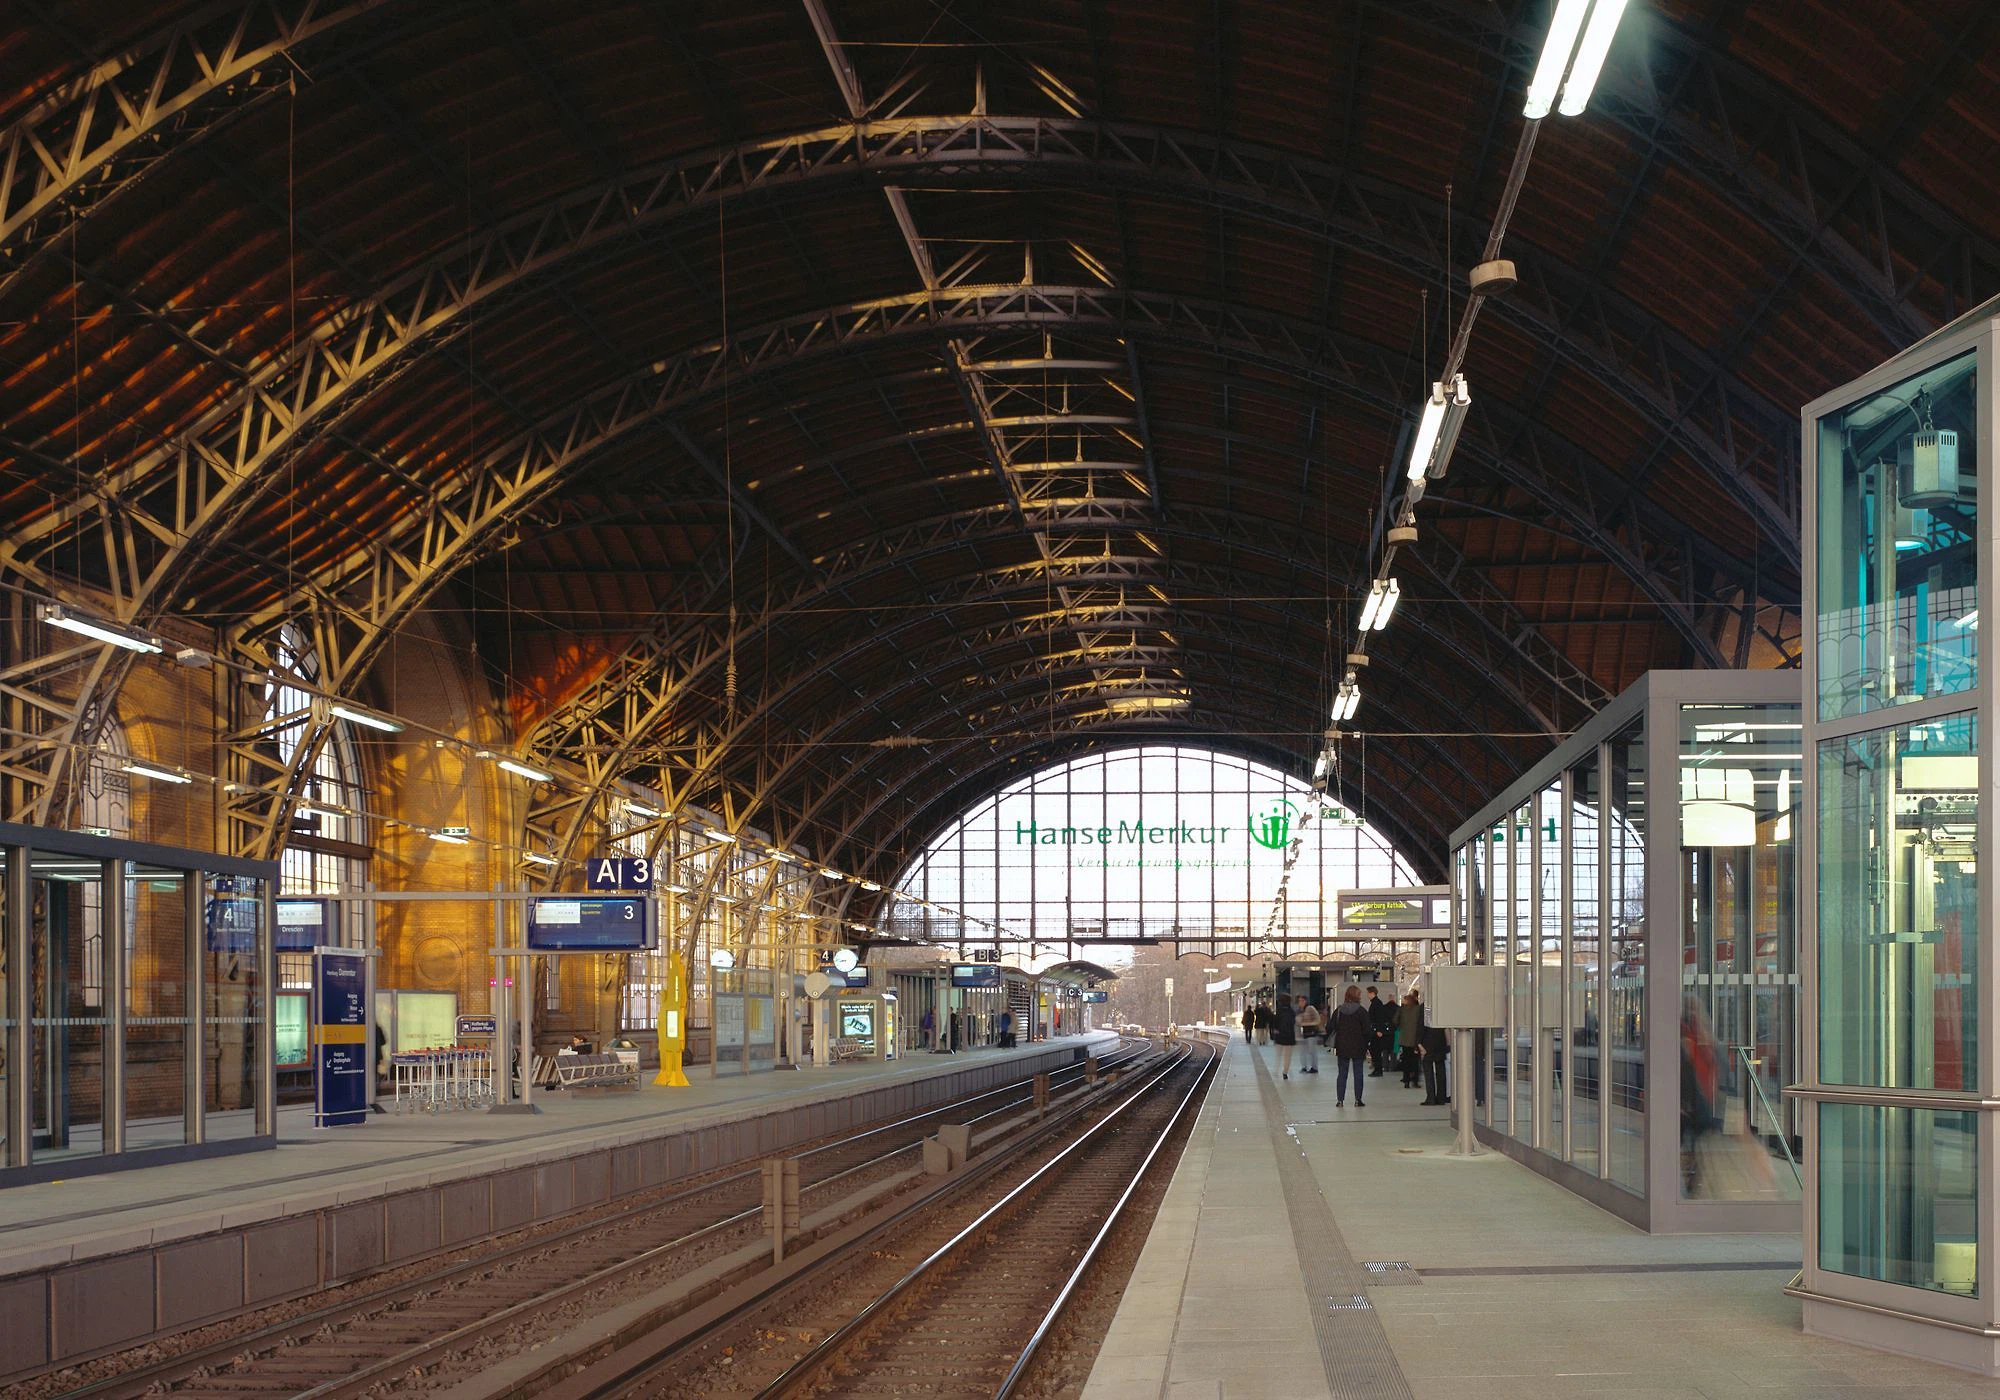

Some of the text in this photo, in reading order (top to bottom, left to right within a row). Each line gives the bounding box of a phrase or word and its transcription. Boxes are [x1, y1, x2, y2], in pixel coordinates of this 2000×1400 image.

[1016, 820, 1231, 845] HanseMerkur
[596, 858, 649, 883] A 3
[224, 907, 233, 922] 4
[624, 905, 634, 920] 3
[822, 950, 829, 961] 4
[979, 950, 1000, 960] B 3
